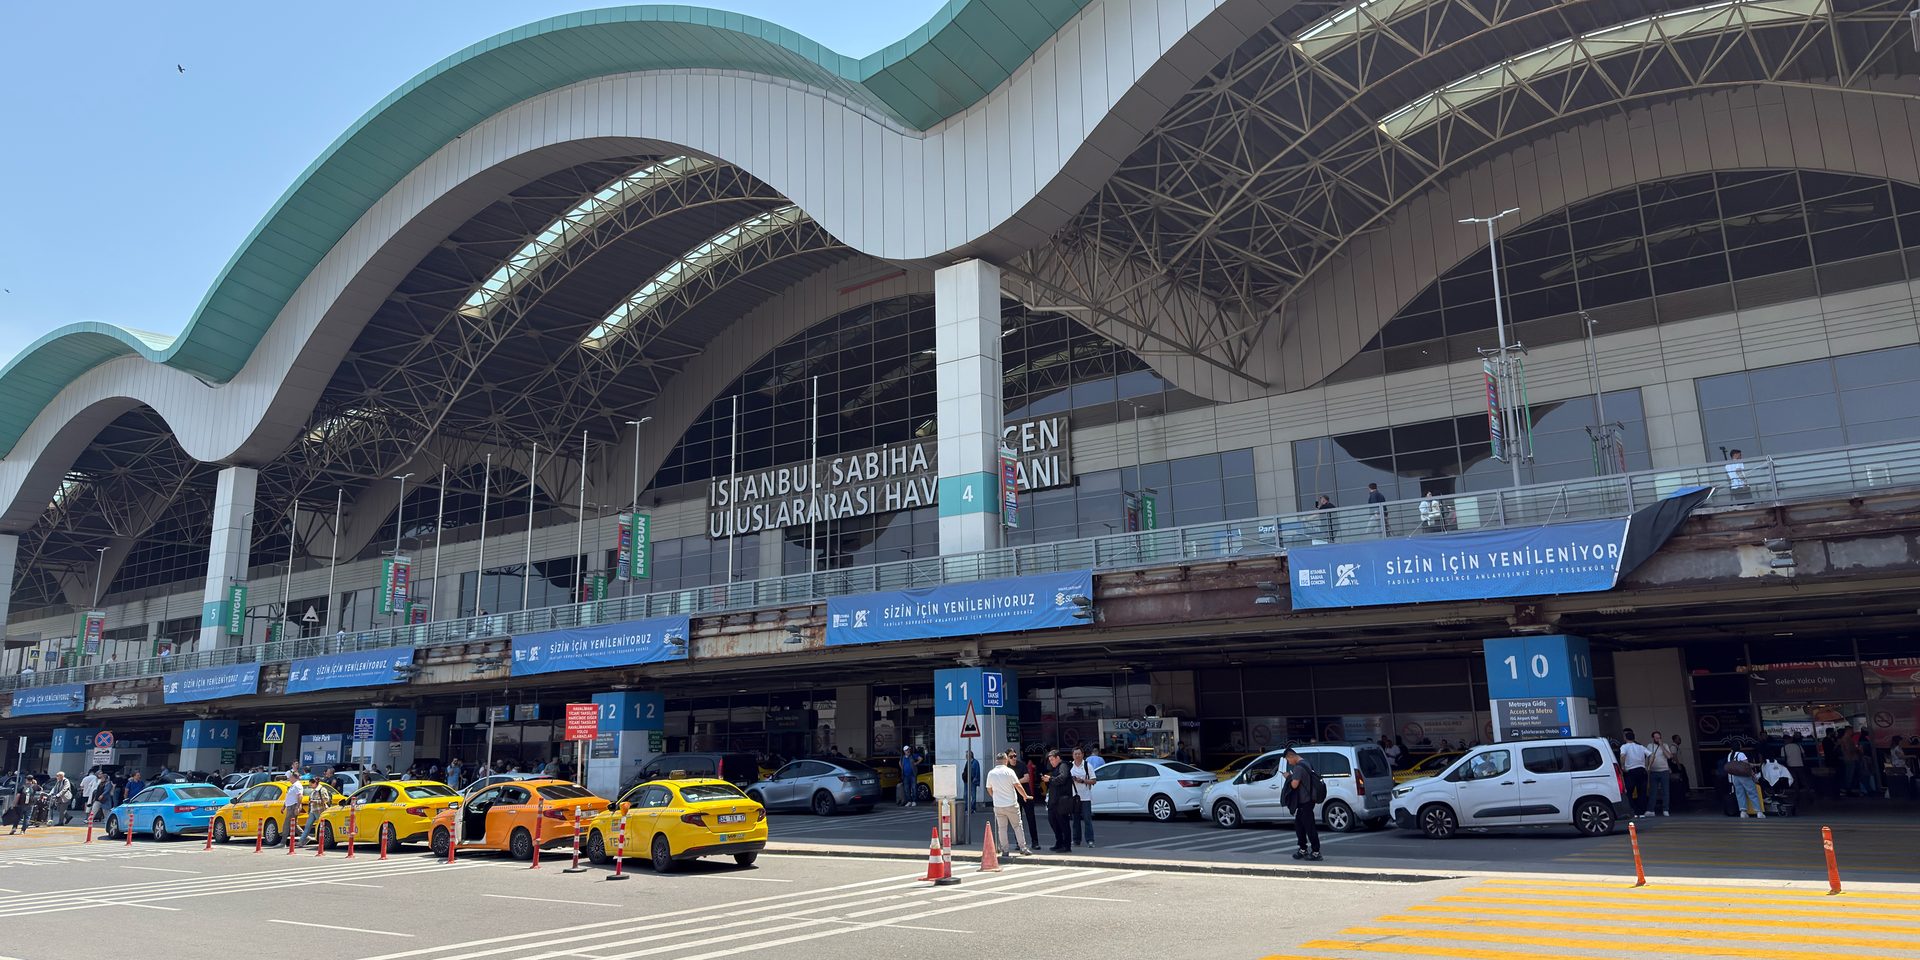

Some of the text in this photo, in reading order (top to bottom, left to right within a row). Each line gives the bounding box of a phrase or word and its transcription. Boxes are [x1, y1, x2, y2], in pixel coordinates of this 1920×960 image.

[711, 464, 821, 506] İSTANBUL
[832, 443, 928, 486] SABİHA
[962, 484, 974, 503] 4
[710, 486, 875, 538] ULUSLARARASI
[636, 516, 646, 575] ENUYGUN
[1386, 554, 1433, 576] SİZİN
[1441, 551, 1479, 574] İÇİN
[1387, 577, 1420, 585] TADİLAT
[1425, 575, 1470, 583] SÜRESİNCE
[1475, 570, 1530, 580] ANLAYIŞINIZ
[1535, 567, 1554, 576] İÇİN
[1560, 565, 1605, 574] TEŞEKKÜR
[210, 608, 217, 620] 5
[231, 588, 242, 633] ENUYGUN
[884, 603, 911, 619] SİZİN
[916, 601, 939, 619] İÇİN
[944, 593, 1035, 613] YENİLENİYORUZ
[550, 641, 569, 654] SİZİN
[572, 638, 587, 653] İÇİN
[590, 633, 652, 649] YENİLENİYORUZ
[316, 665, 331, 675] SİZİN
[344, 659, 388, 672] YENİLENİYORUZ
[1504, 654, 1549, 680] 10
[1574, 654, 1588, 678] 10
[988, 675, 997, 691] D
[1775, 678, 1795, 686] Gelen
[1798, 677, 1815, 685] Yolcu
[944, 681, 968, 701] 11
[598, 703, 616, 720] 12
[634, 703, 655, 719] 12
[1532, 700, 1546, 708] Gidiş
[186, 727, 196, 740] 14
[209, 727, 230, 740] 14
[386, 718, 407, 732] 13
[54, 735, 63, 746] 15
[73, 735, 93, 746] 15
